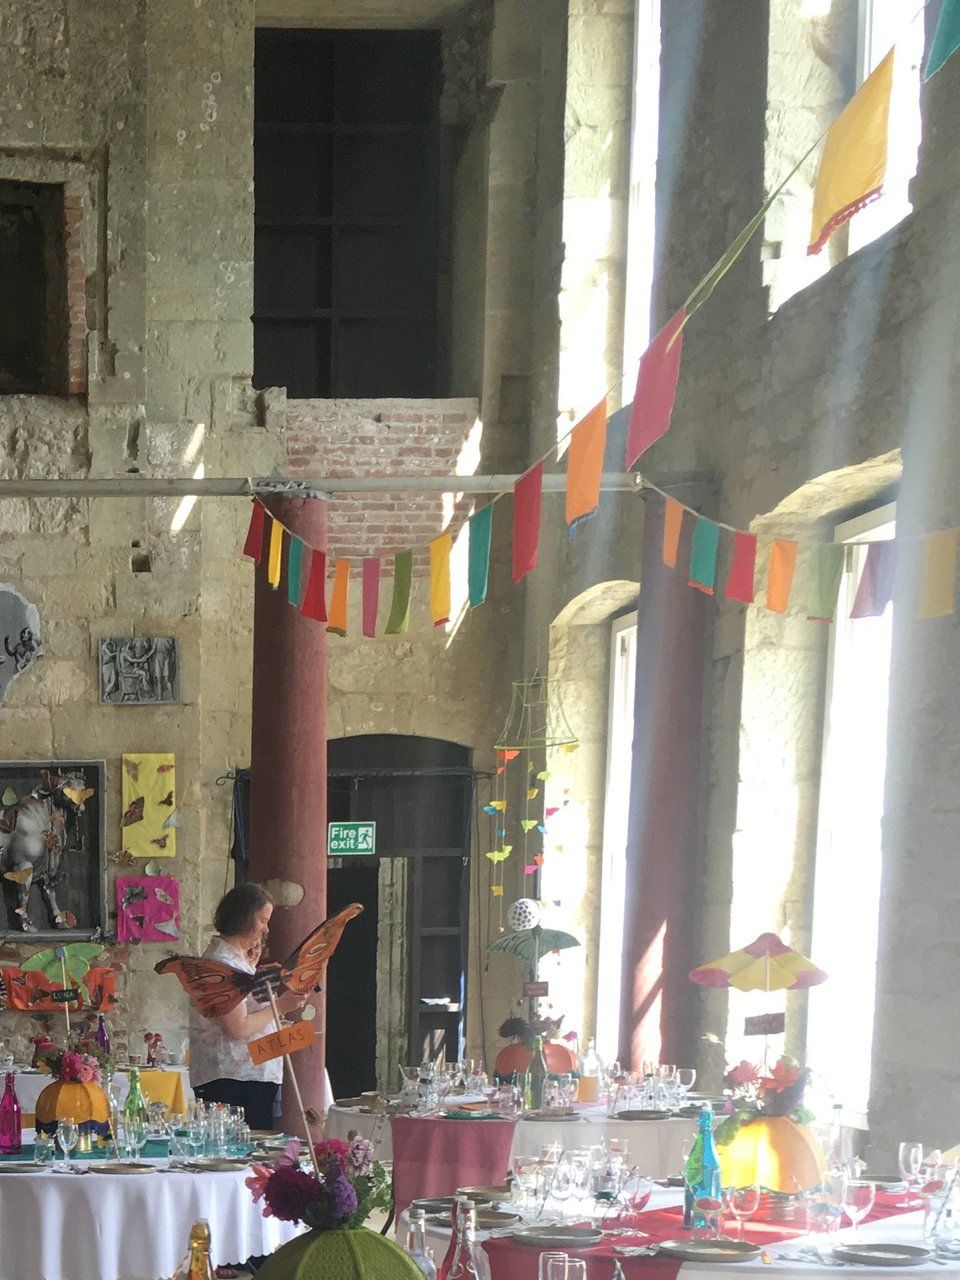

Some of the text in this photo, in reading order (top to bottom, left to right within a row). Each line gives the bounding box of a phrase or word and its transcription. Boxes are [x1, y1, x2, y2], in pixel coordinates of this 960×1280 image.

[331, 827, 356, 838] Fire
[330, 838, 355, 849] exit
[53, 991, 74, 1000] LUNA
[255, 1029, 306, 1056] ATLAS
